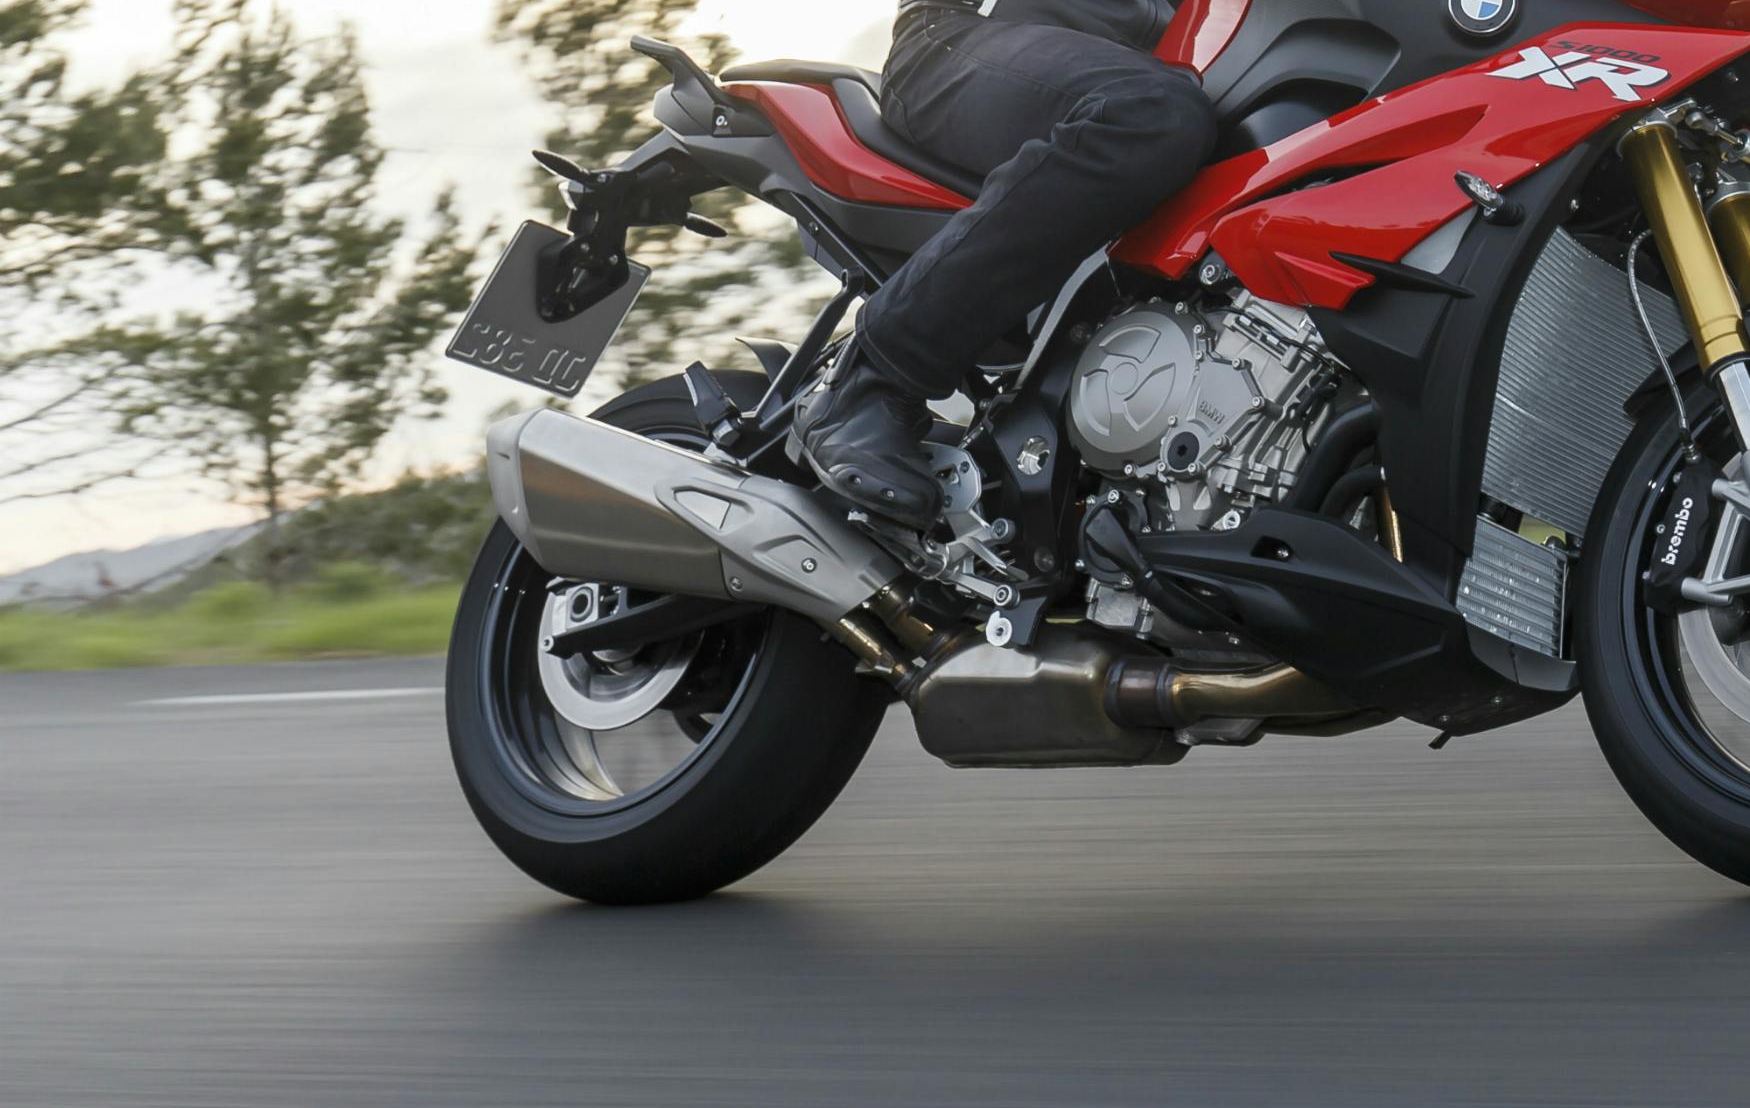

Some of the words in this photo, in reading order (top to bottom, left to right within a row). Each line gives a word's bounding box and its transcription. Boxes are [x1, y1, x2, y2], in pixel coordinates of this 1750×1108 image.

[1484, 45, 1671, 102] XR
[1199, 400, 1226, 425] BMW
[1661, 497, 1694, 565] brembo
